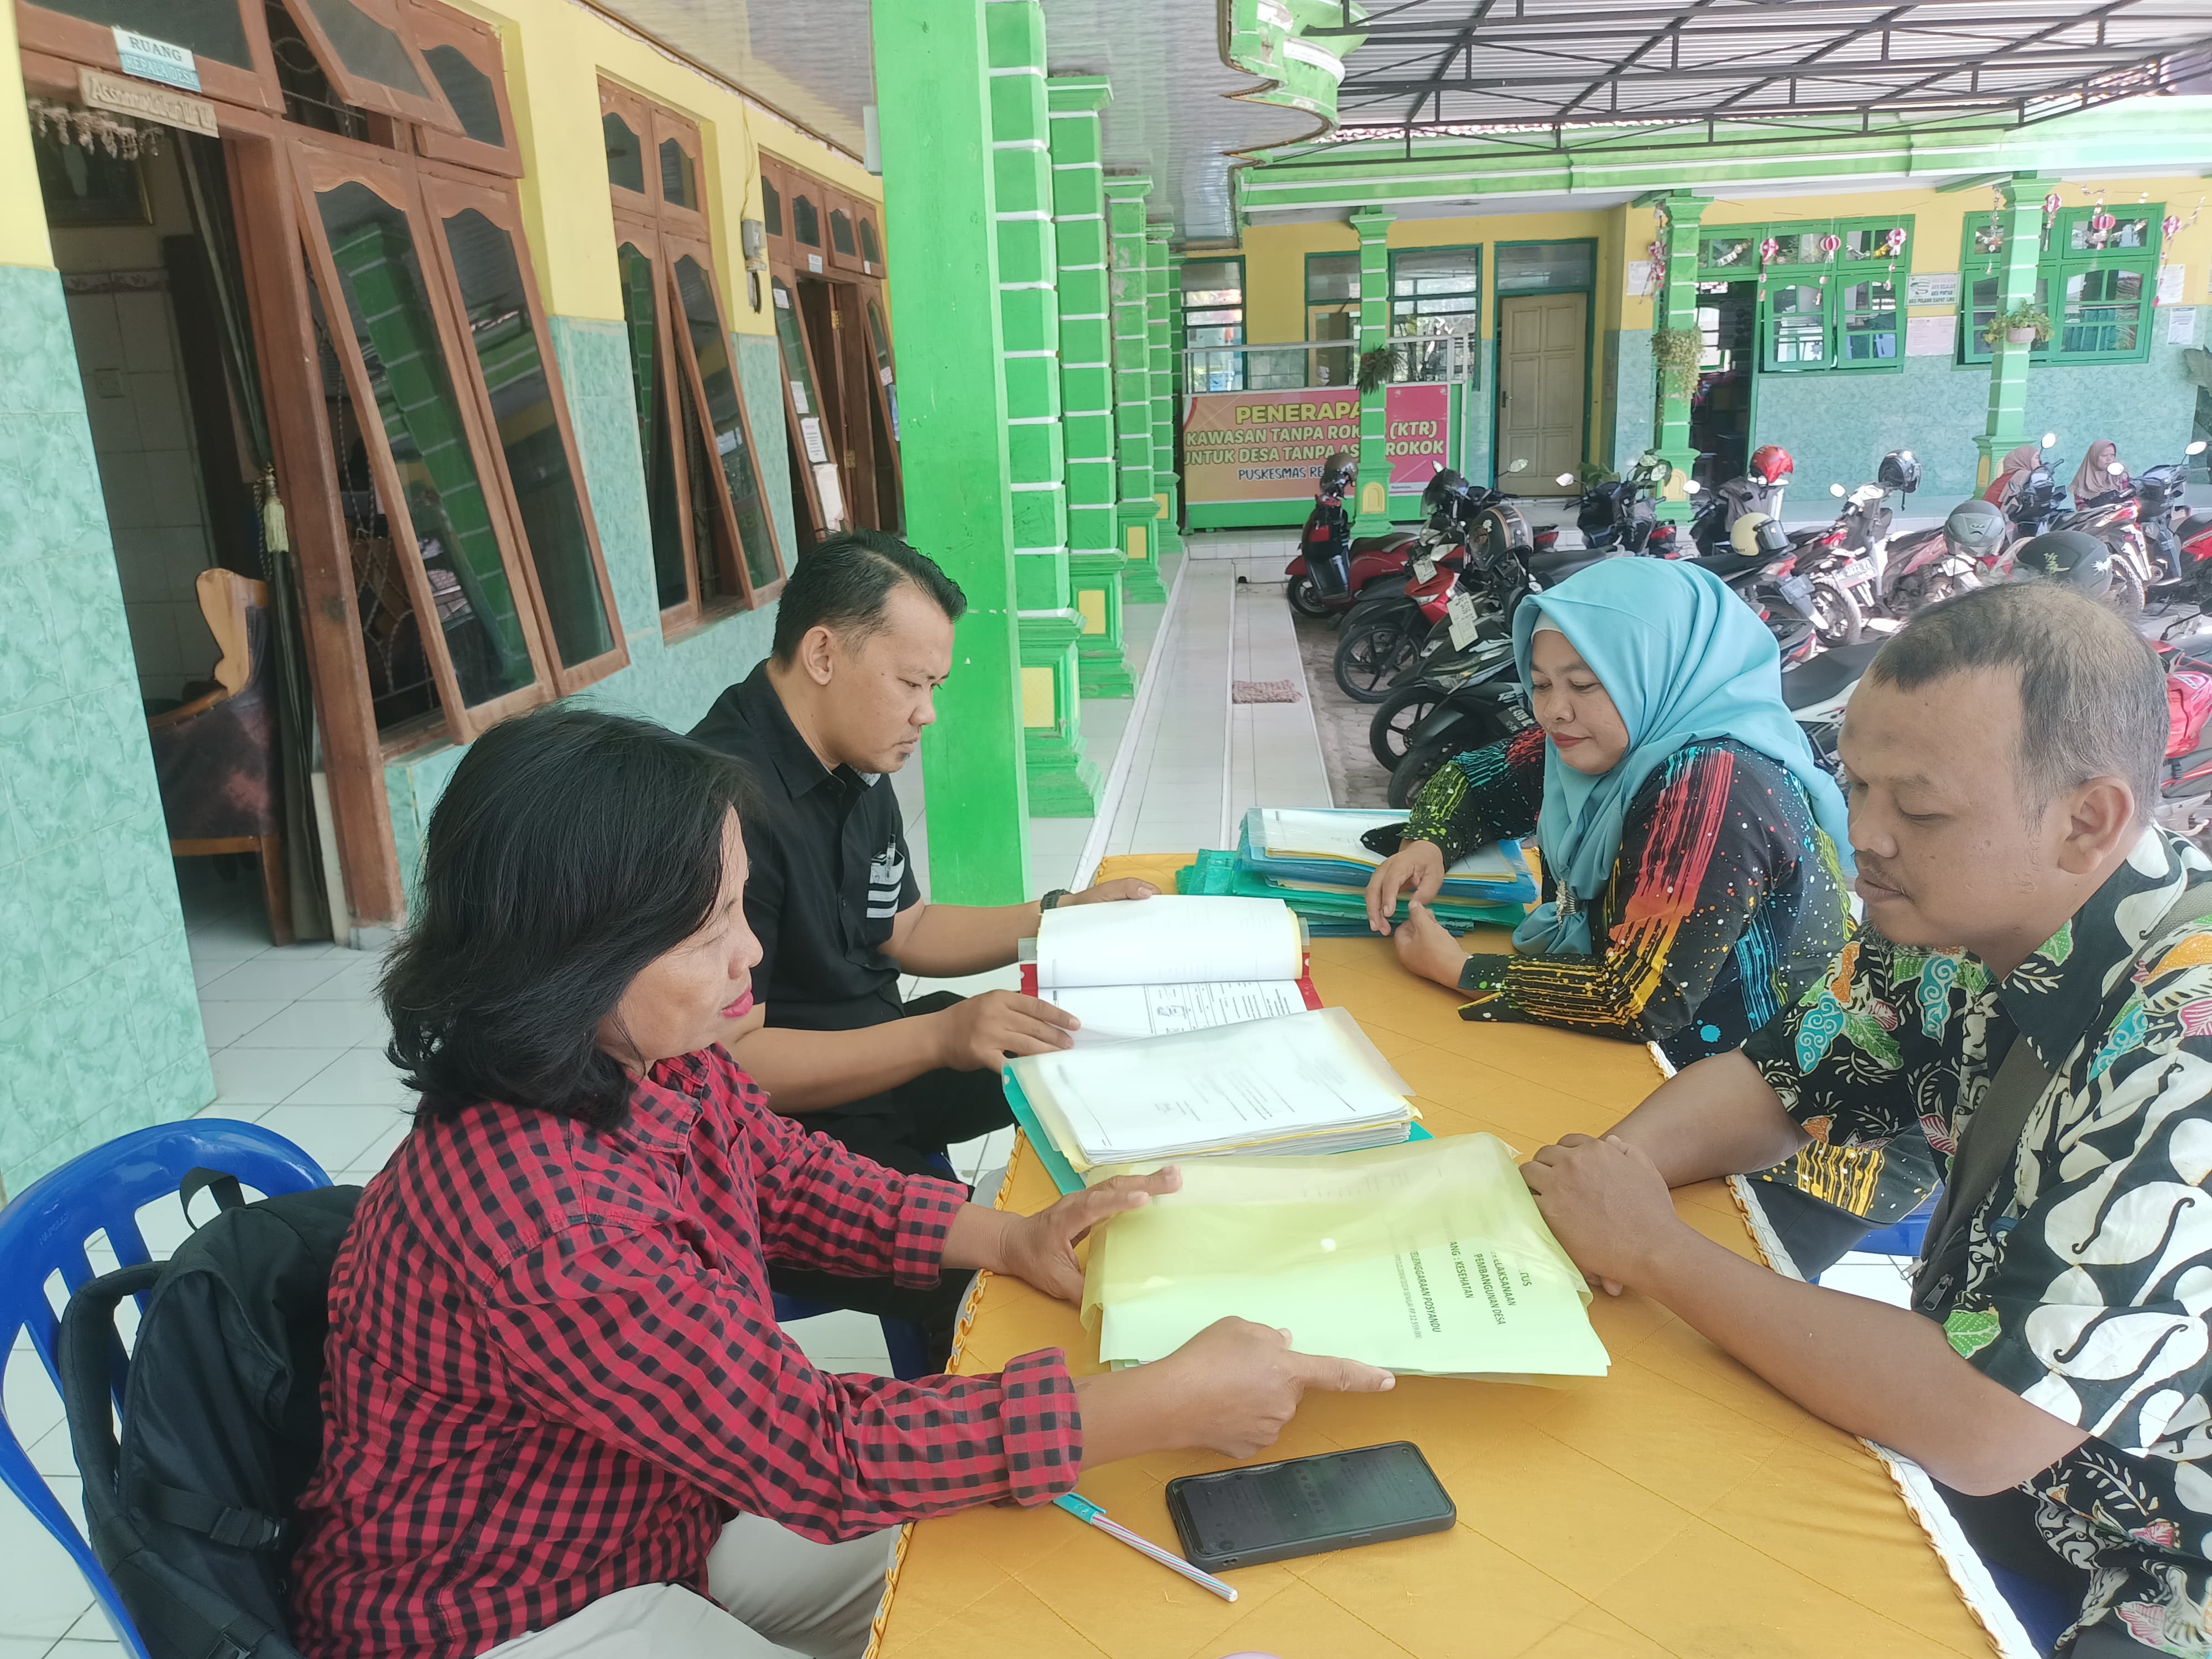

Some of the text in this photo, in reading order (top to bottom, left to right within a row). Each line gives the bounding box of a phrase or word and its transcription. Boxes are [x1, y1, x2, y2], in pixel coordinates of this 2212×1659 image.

[129, 36, 182, 62] RUANG
[126, 56, 198, 86] KEPALA DESA
[1235, 400, 1360, 425] PENERAPA
[1186, 421, 1437, 446] KAWASAN TANPA ROK (KTR)
[1184, 440, 1444, 466] UNTUK DESA TANPA AS ROKOK
[1239, 467, 1306, 481] PUSKESMAS
[1455, 1261, 1474, 1298] KESEHATAN
[1474, 1253, 1506, 1325] PEMBANGUNAN DESA
[1423, 1297, 1442, 1332] POSYANDU
